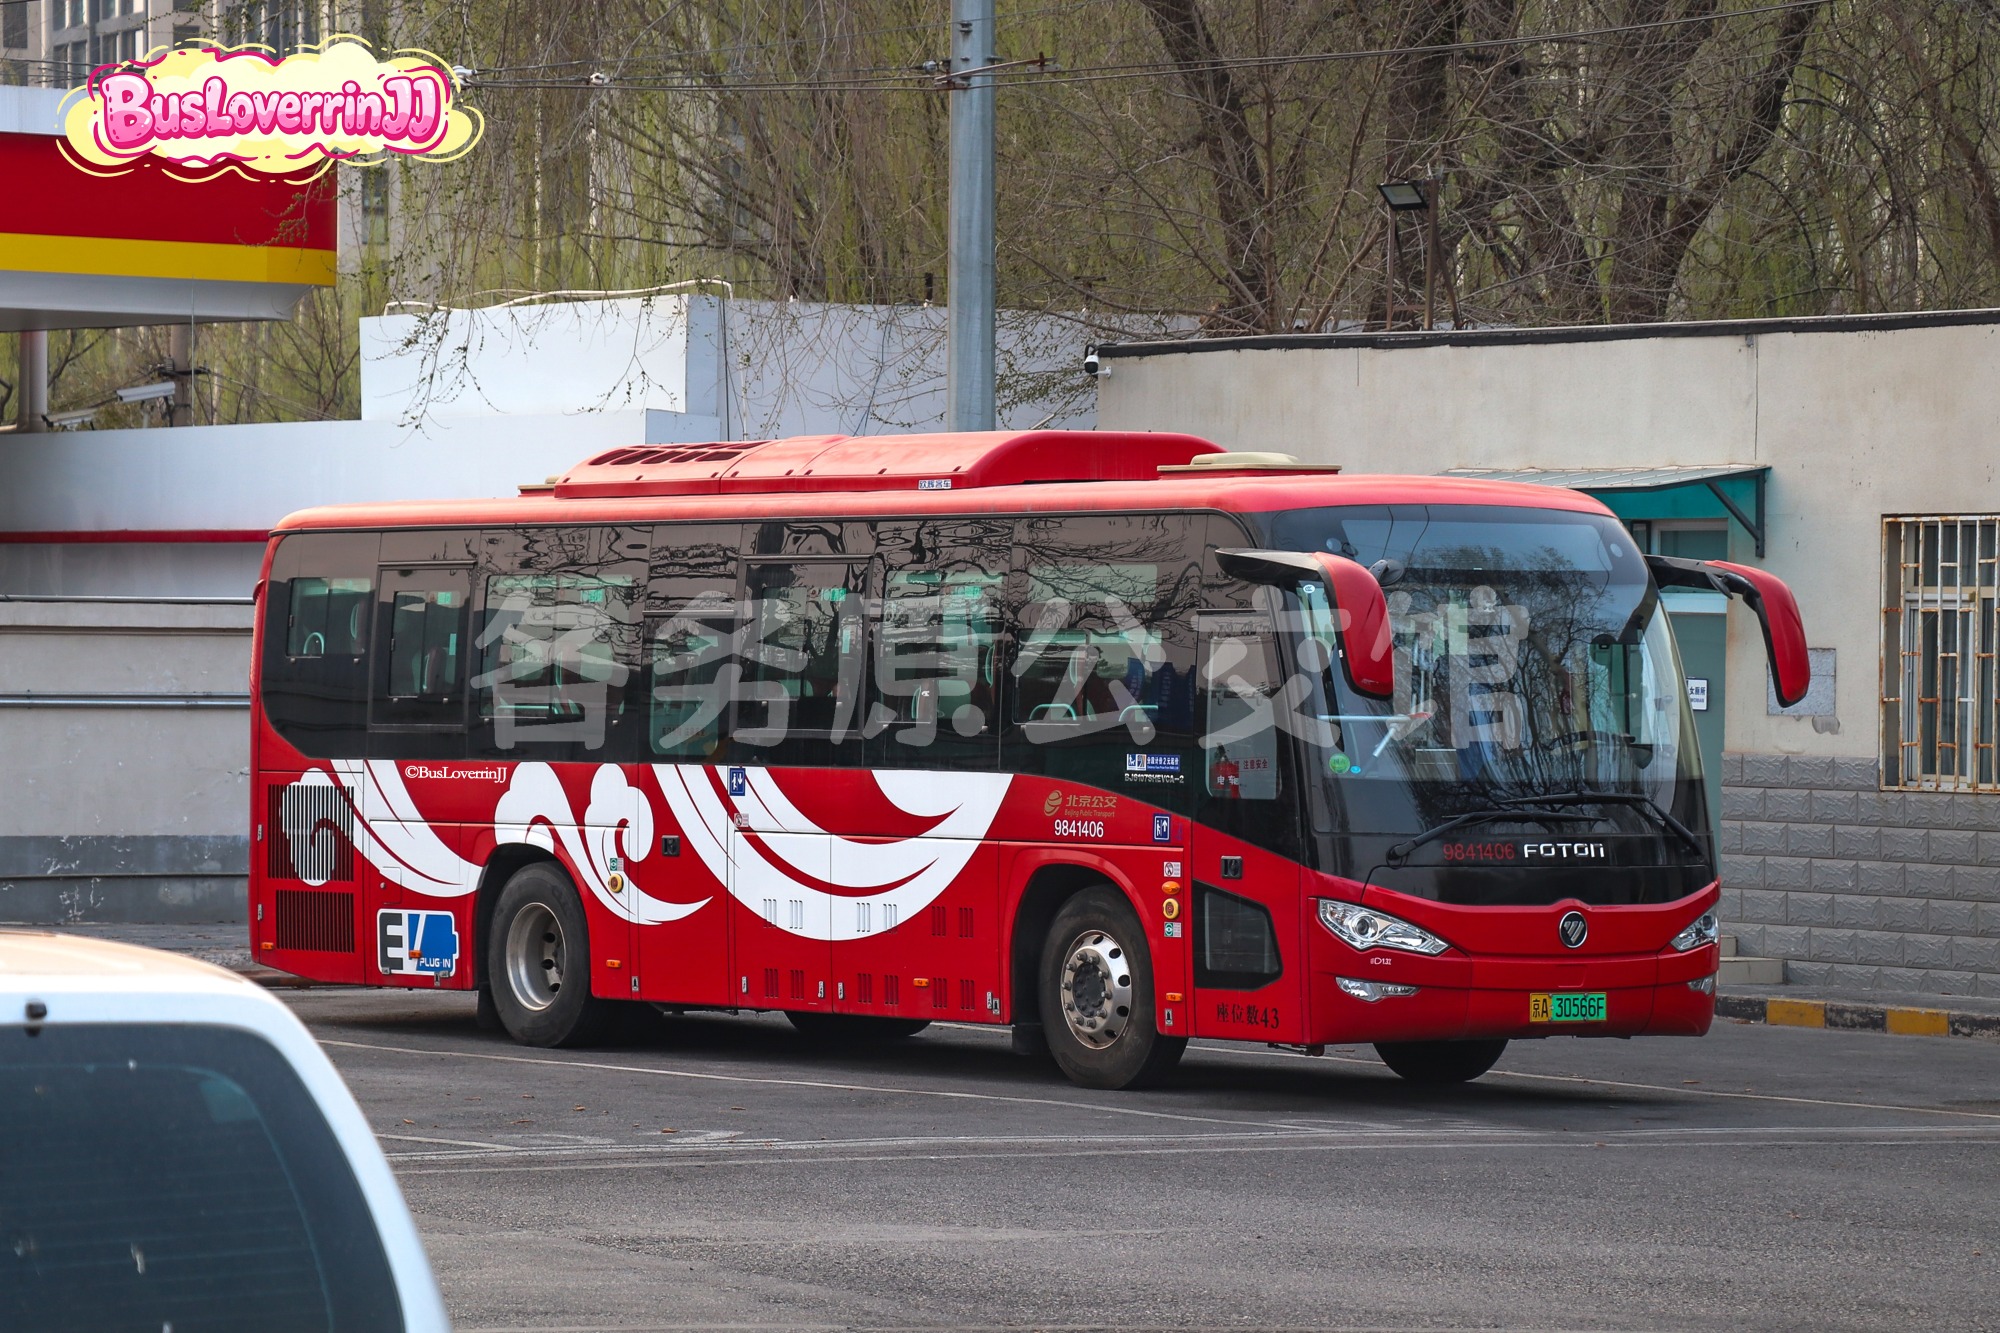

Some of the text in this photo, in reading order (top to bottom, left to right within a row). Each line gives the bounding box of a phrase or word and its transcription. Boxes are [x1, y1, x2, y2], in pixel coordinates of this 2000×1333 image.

[1243, 758, 1268, 770] 注意安全
[1065, 794, 1118, 808] 北京公交
[1064, 808, 1116, 818] Beijing Public Transport
[1054, 819, 1105, 838] 9841406
[1443, 843, 1605, 861] 9841406 FOTON
[419, 957, 452, 969] PLUG-IN
[1216, 1002, 1280, 1029] 座位数43
[1532, 997, 1605, 1018] 京A 30566F
